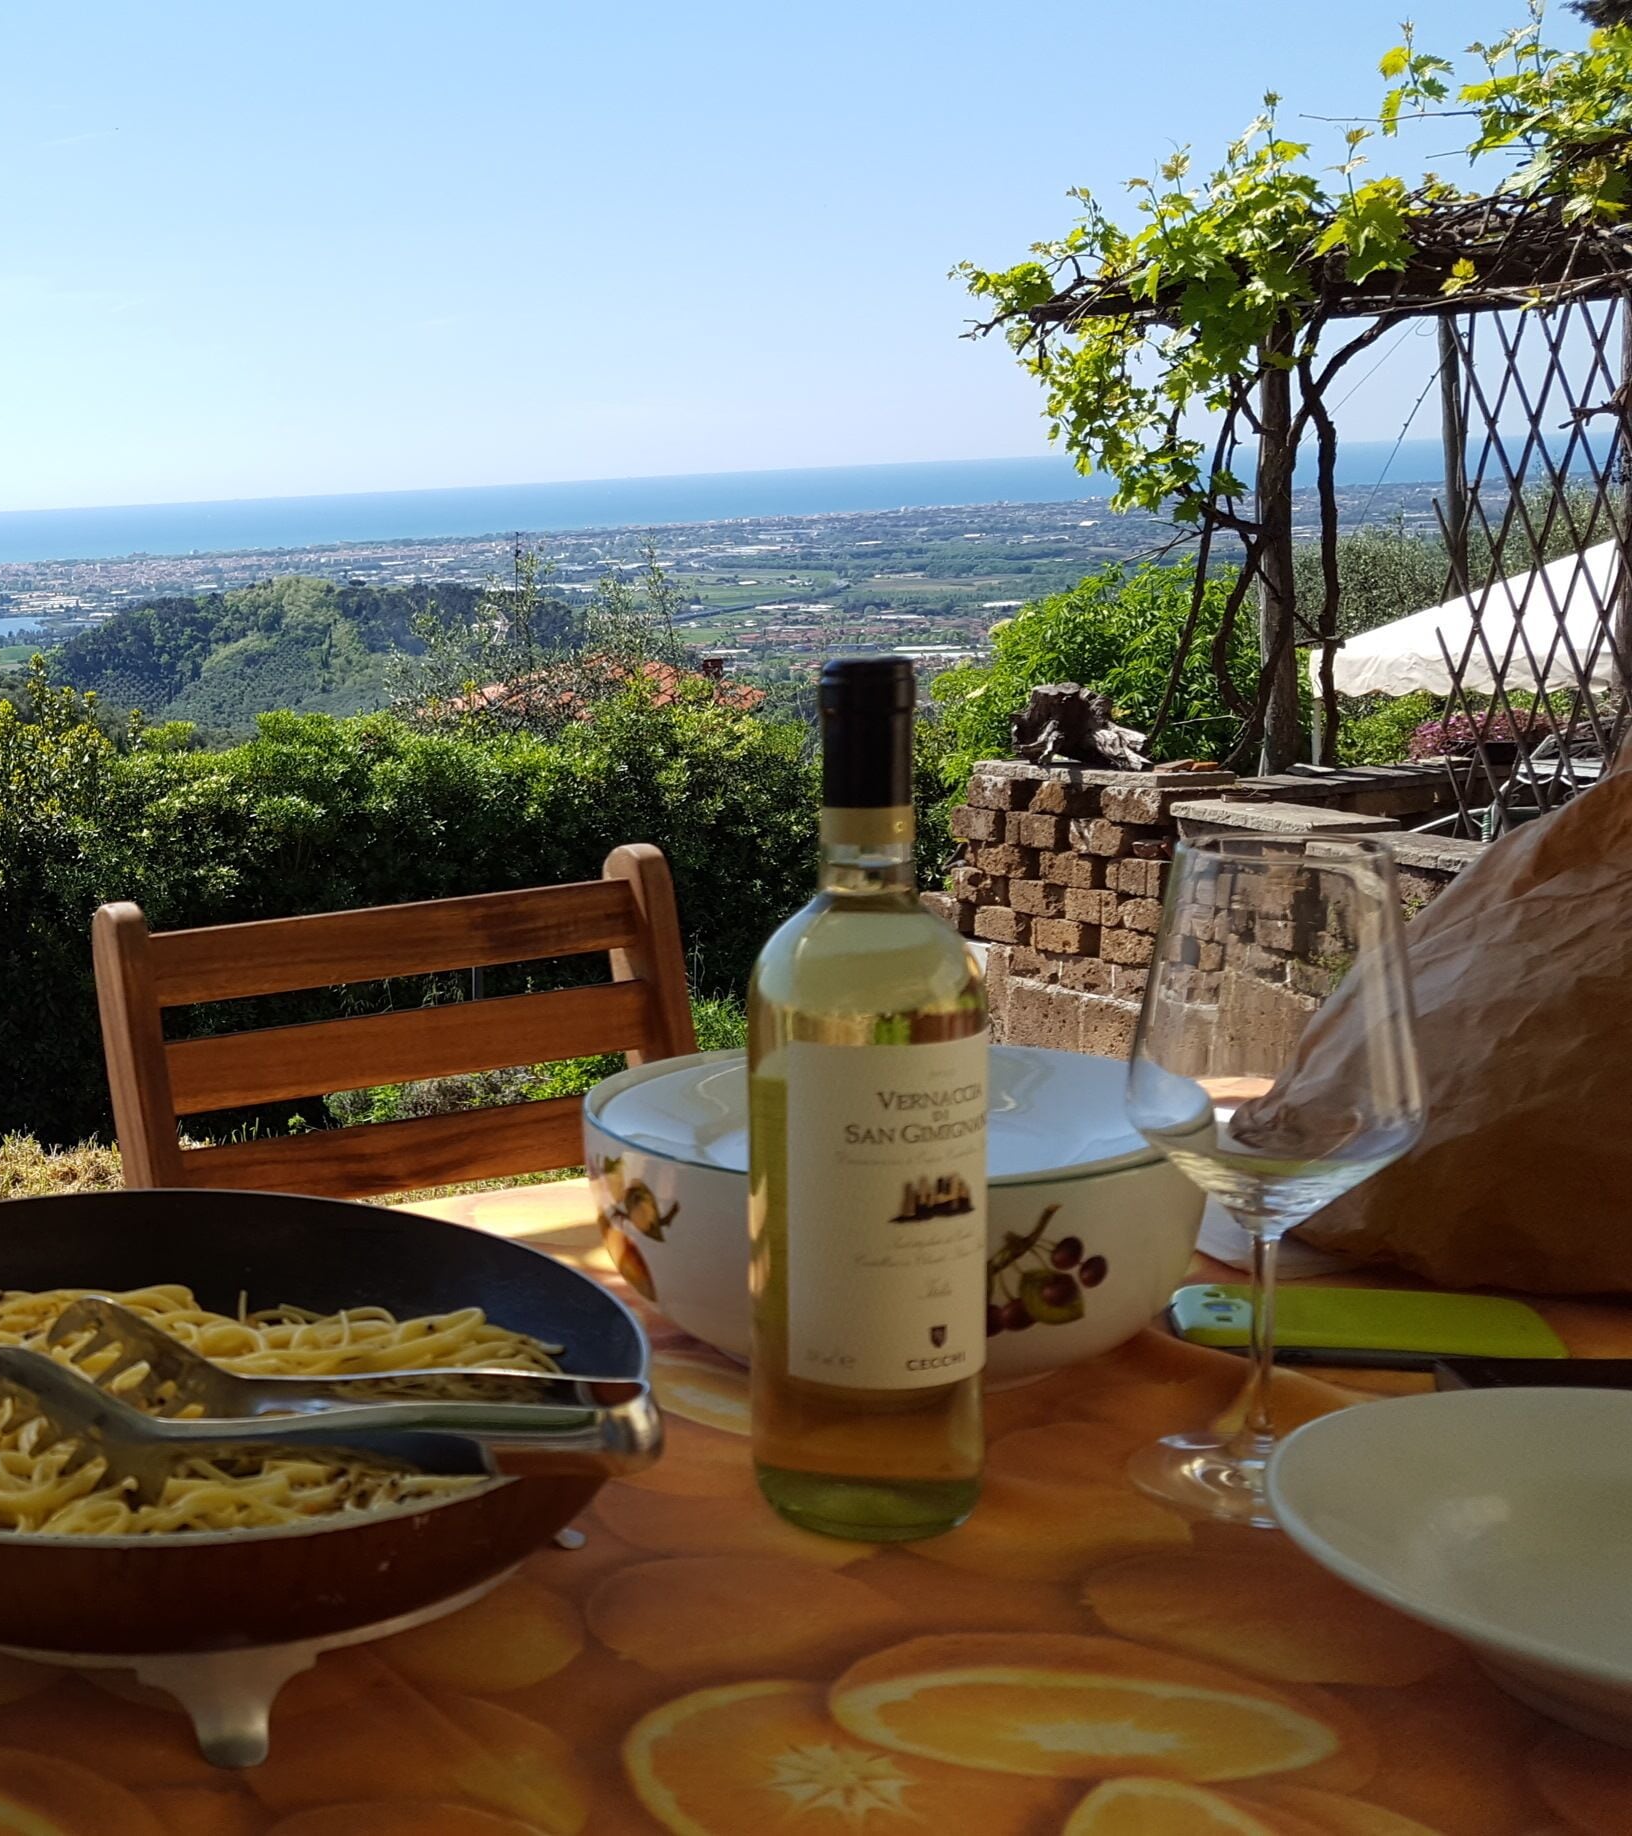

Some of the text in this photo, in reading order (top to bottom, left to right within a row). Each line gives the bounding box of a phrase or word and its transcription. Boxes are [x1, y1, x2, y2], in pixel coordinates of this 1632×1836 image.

[875, 1082, 983, 1111] VERNACCIA
[844, 1123, 896, 1145] SAN
[906, 1351, 966, 1372] CECCHI
